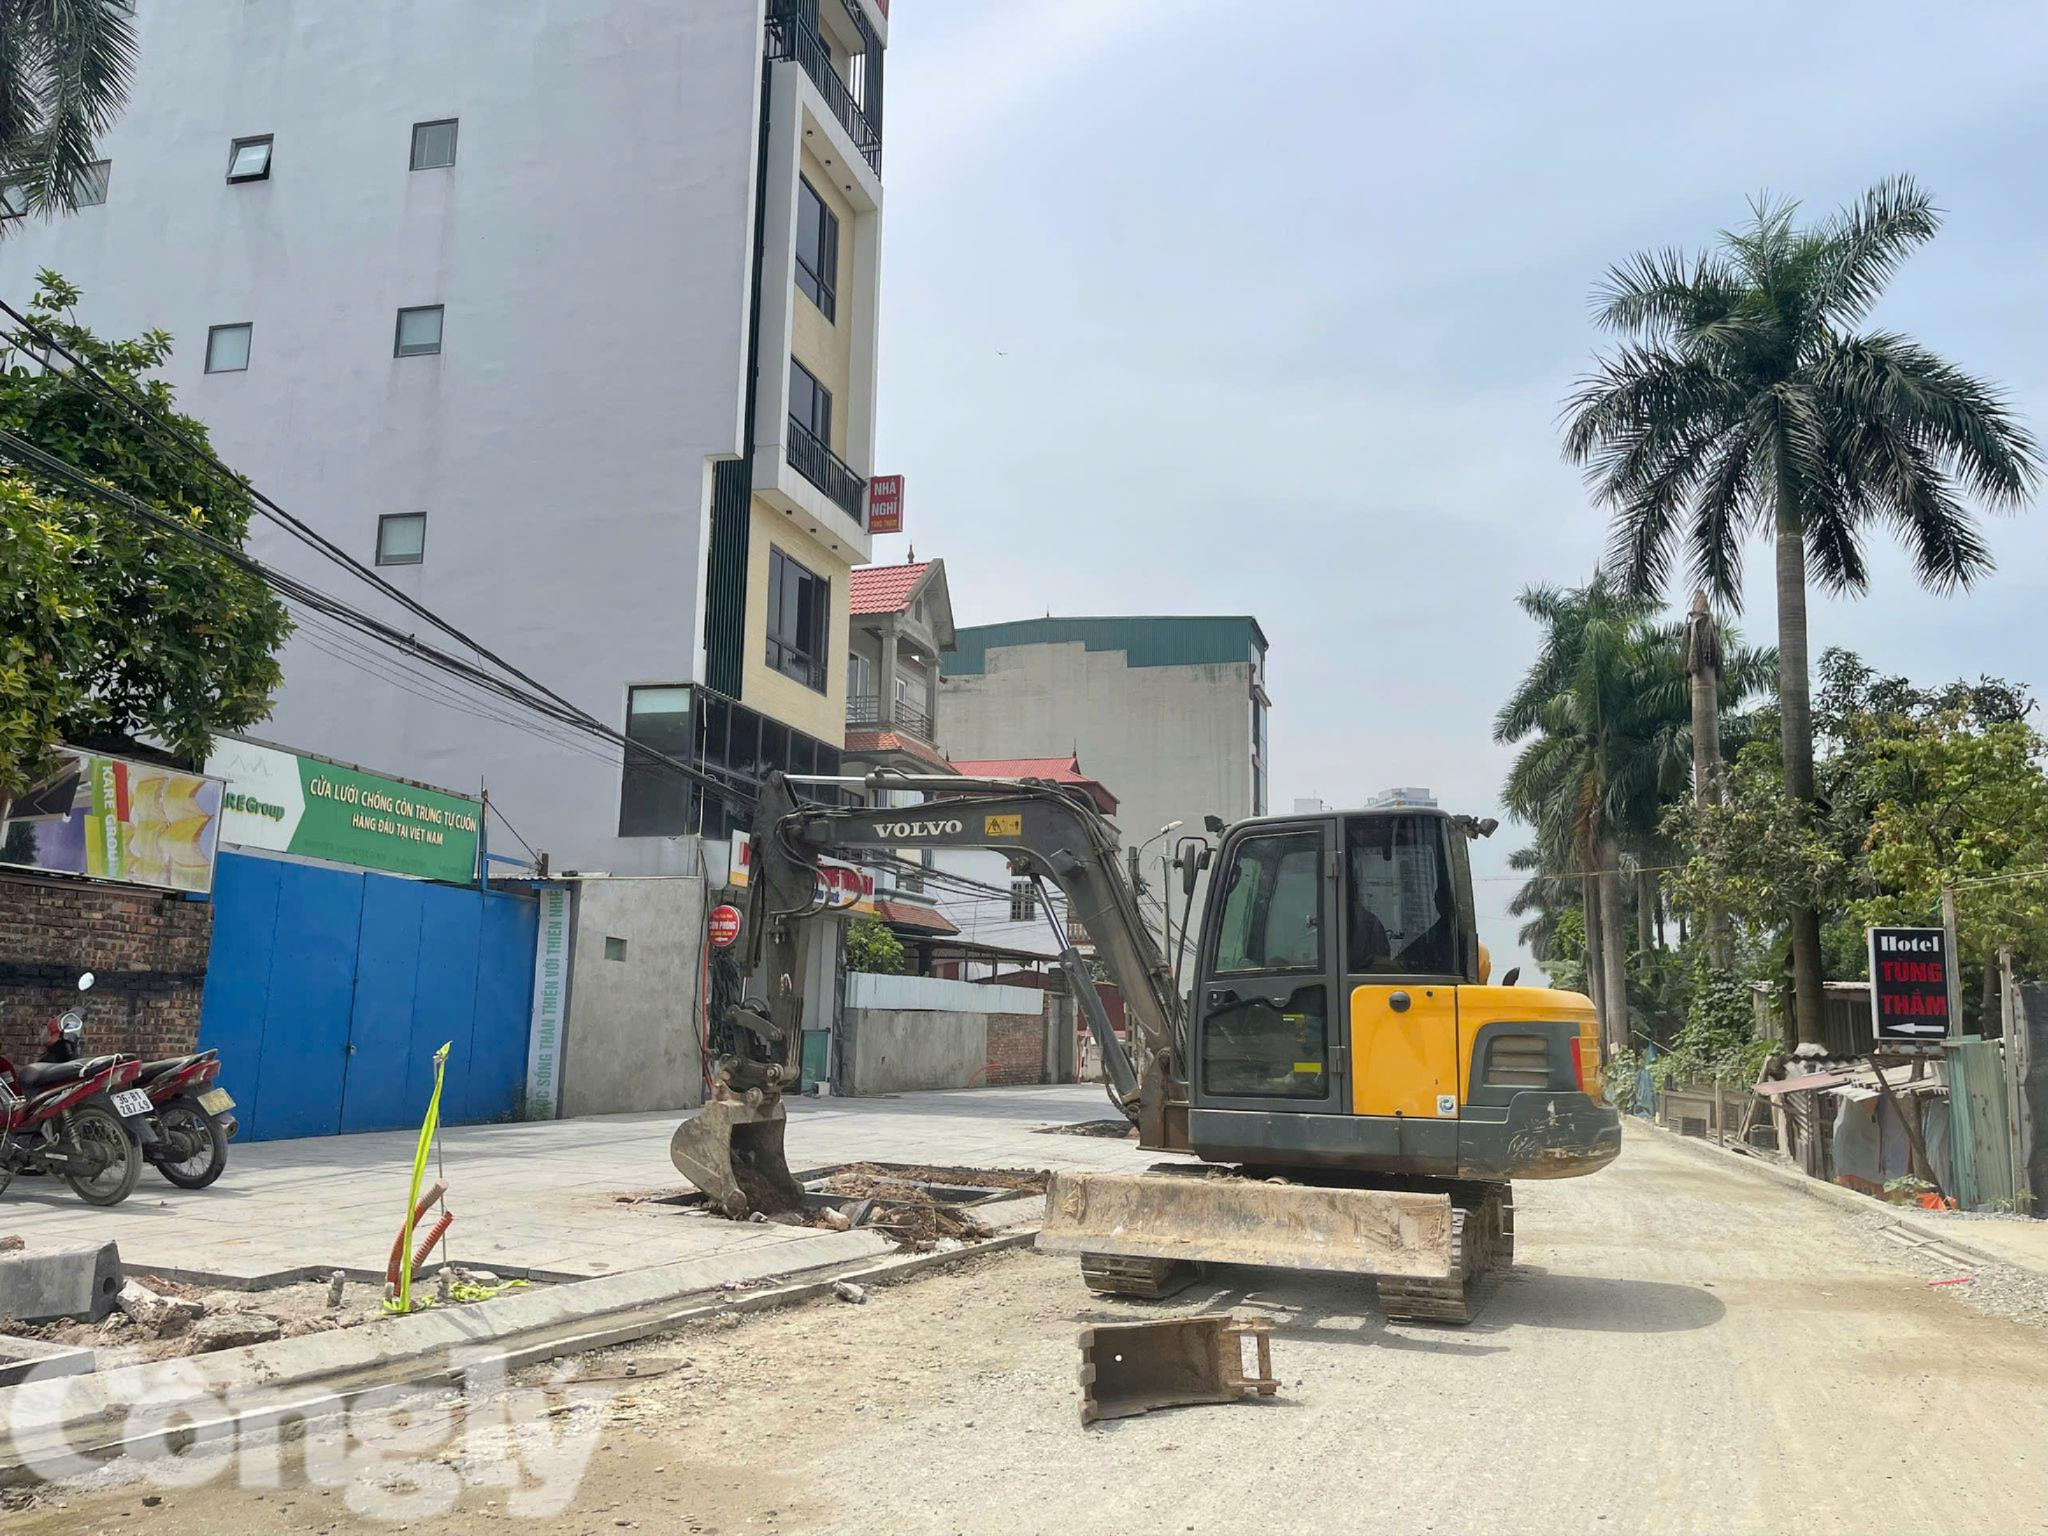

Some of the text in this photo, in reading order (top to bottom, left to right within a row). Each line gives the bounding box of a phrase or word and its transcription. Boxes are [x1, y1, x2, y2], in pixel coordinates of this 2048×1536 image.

[873, 478, 896, 496] NHÀ
[871, 496, 897, 516] NGHỈ
[310, 774, 477, 832] CỬA LƯỚI CHỐNG CÔN TRÙNG TỰ CUỐN
[102, 766, 118, 876] KARE GROU
[352, 812, 376, 831] HÀNG
[396, 823, 408, 839] TẠI
[409, 824, 425, 844] VIỆT
[426, 830, 444, 846] NAM
[872, 819, 963, 838] VOLVO
[544, 921, 562, 955] THIÊN
[1880, 935, 1940, 952] Hotel
[542, 958, 561, 978] VỚI
[1881, 957, 1943, 982] TÙNG
[540, 981, 561, 1015] THIỆN
[533, 1054, 552, 1087] SỐNG
